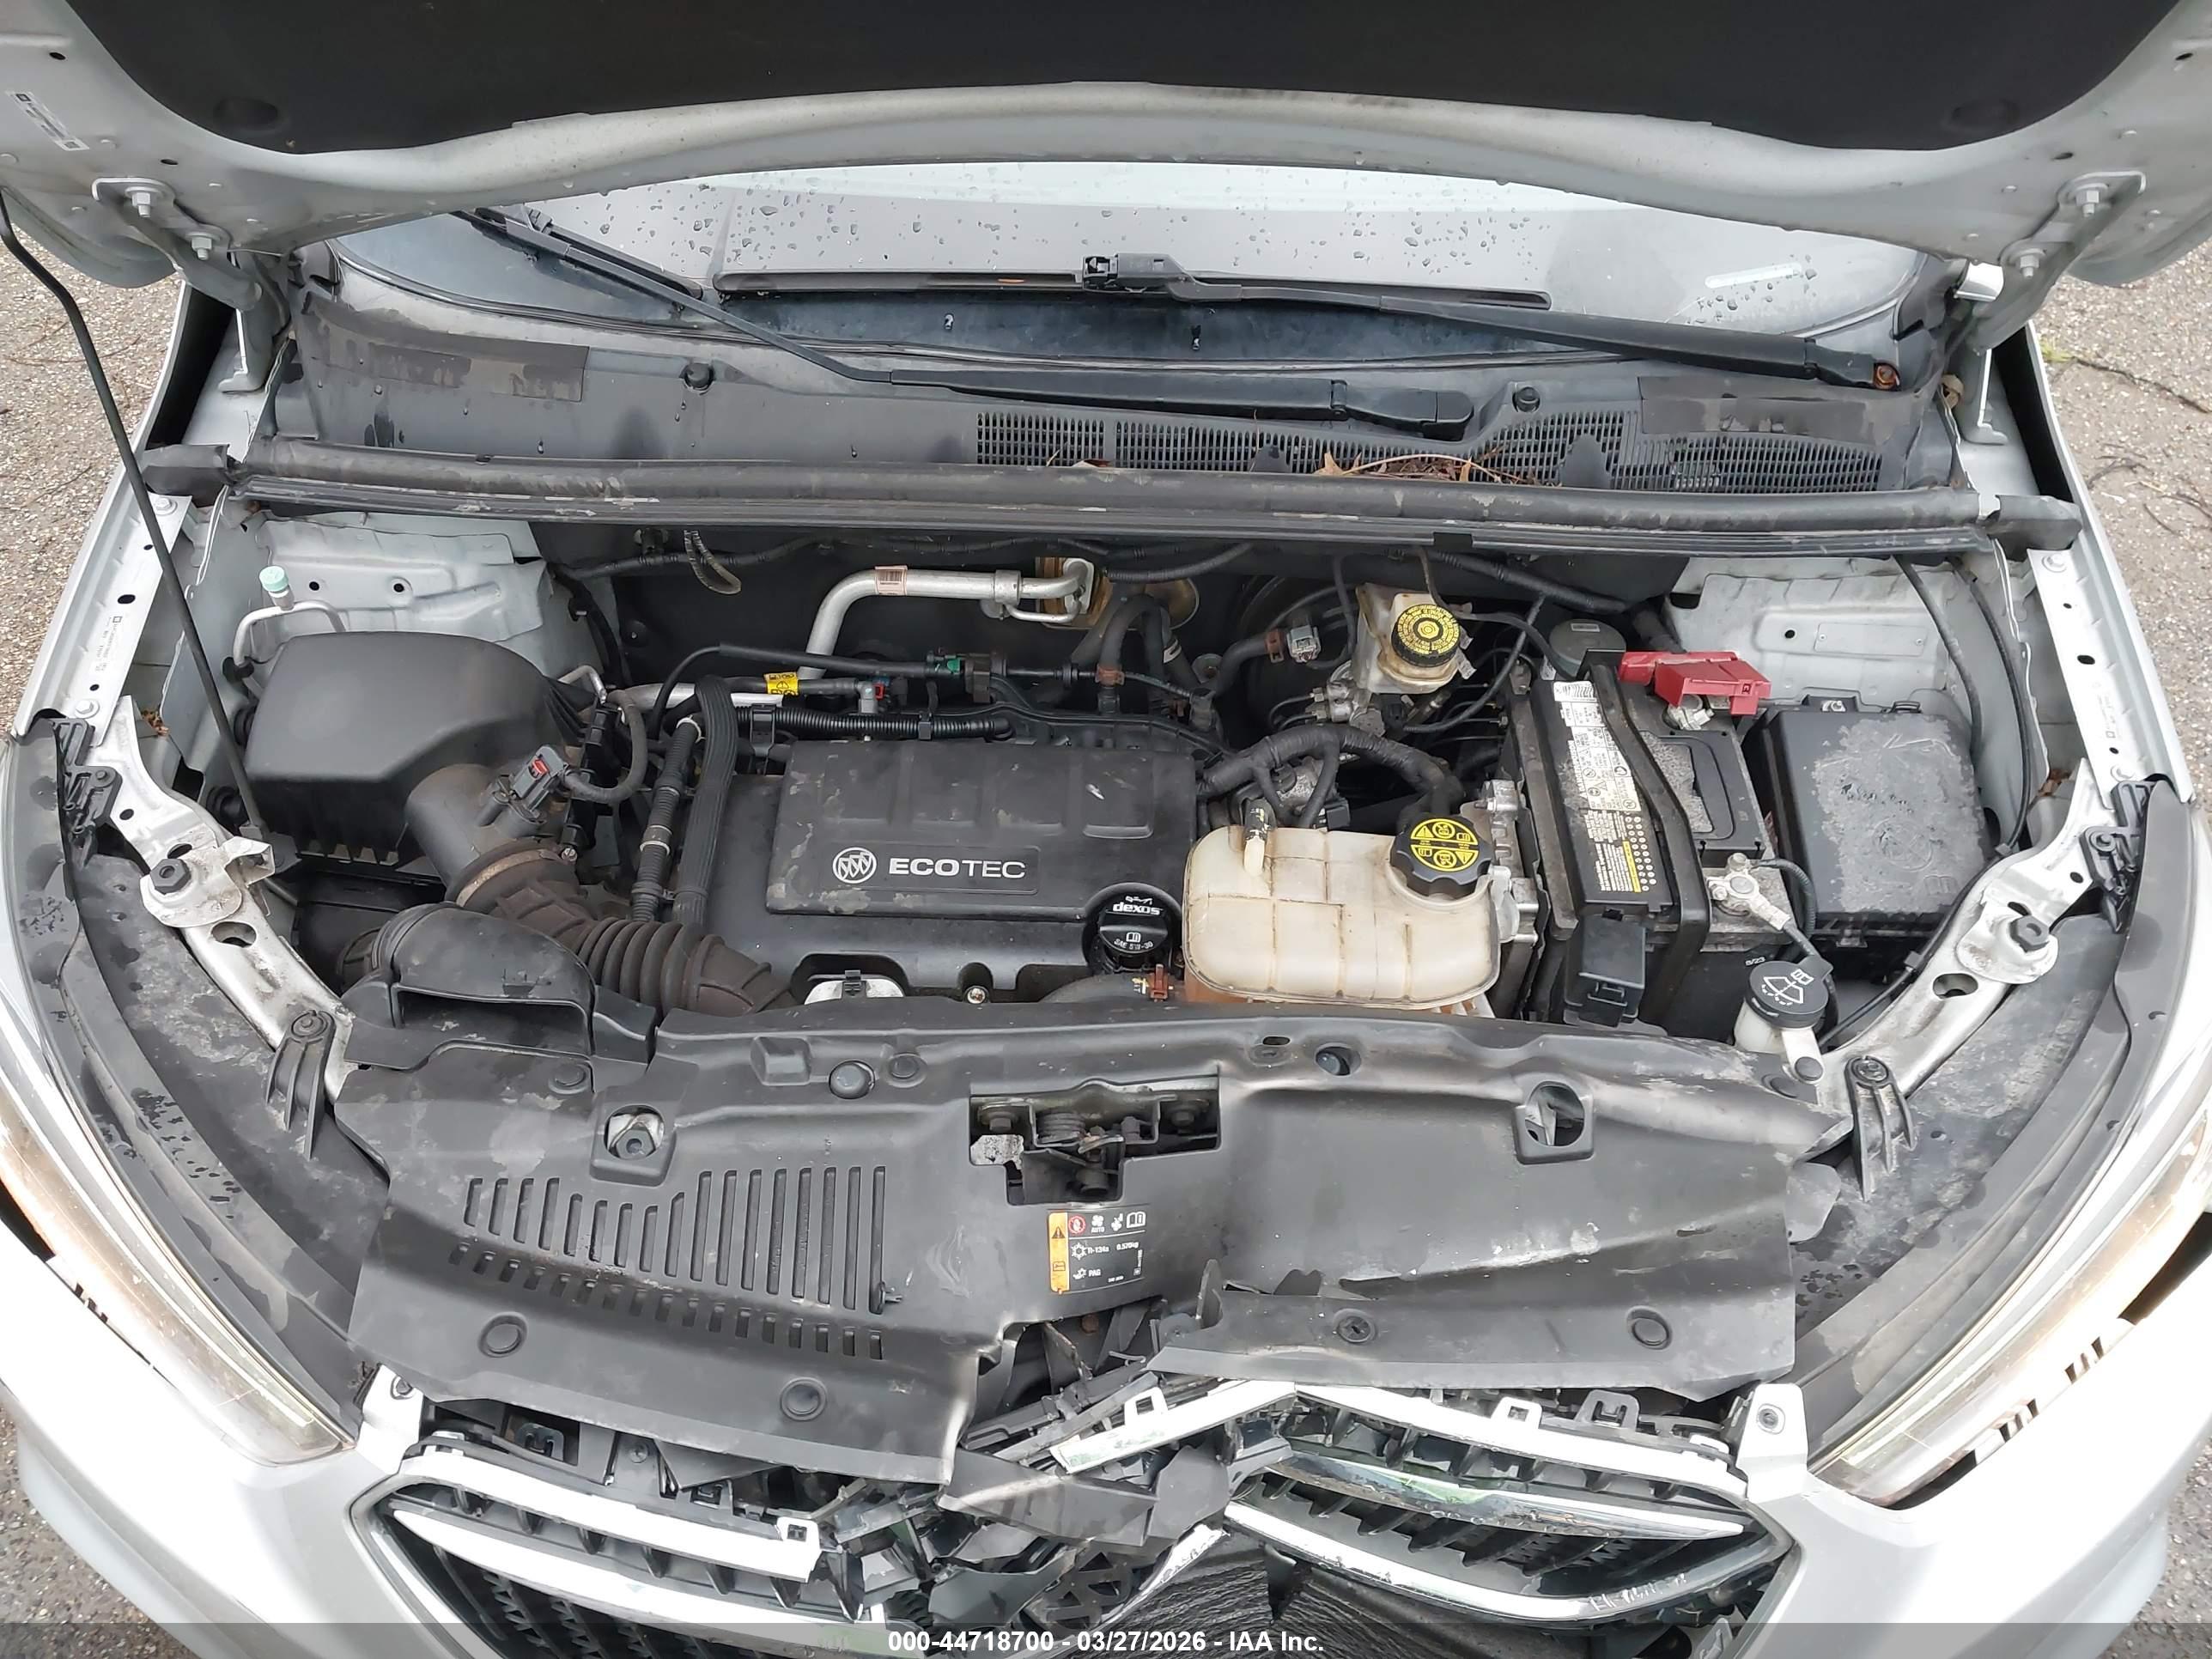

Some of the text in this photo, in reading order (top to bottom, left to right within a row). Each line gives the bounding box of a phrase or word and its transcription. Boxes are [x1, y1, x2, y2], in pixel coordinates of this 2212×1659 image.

[889, 858, 1026, 879] ECOTEC
[1113, 902, 1164, 915] dexos
[1114, 939, 1127, 949] SAE
